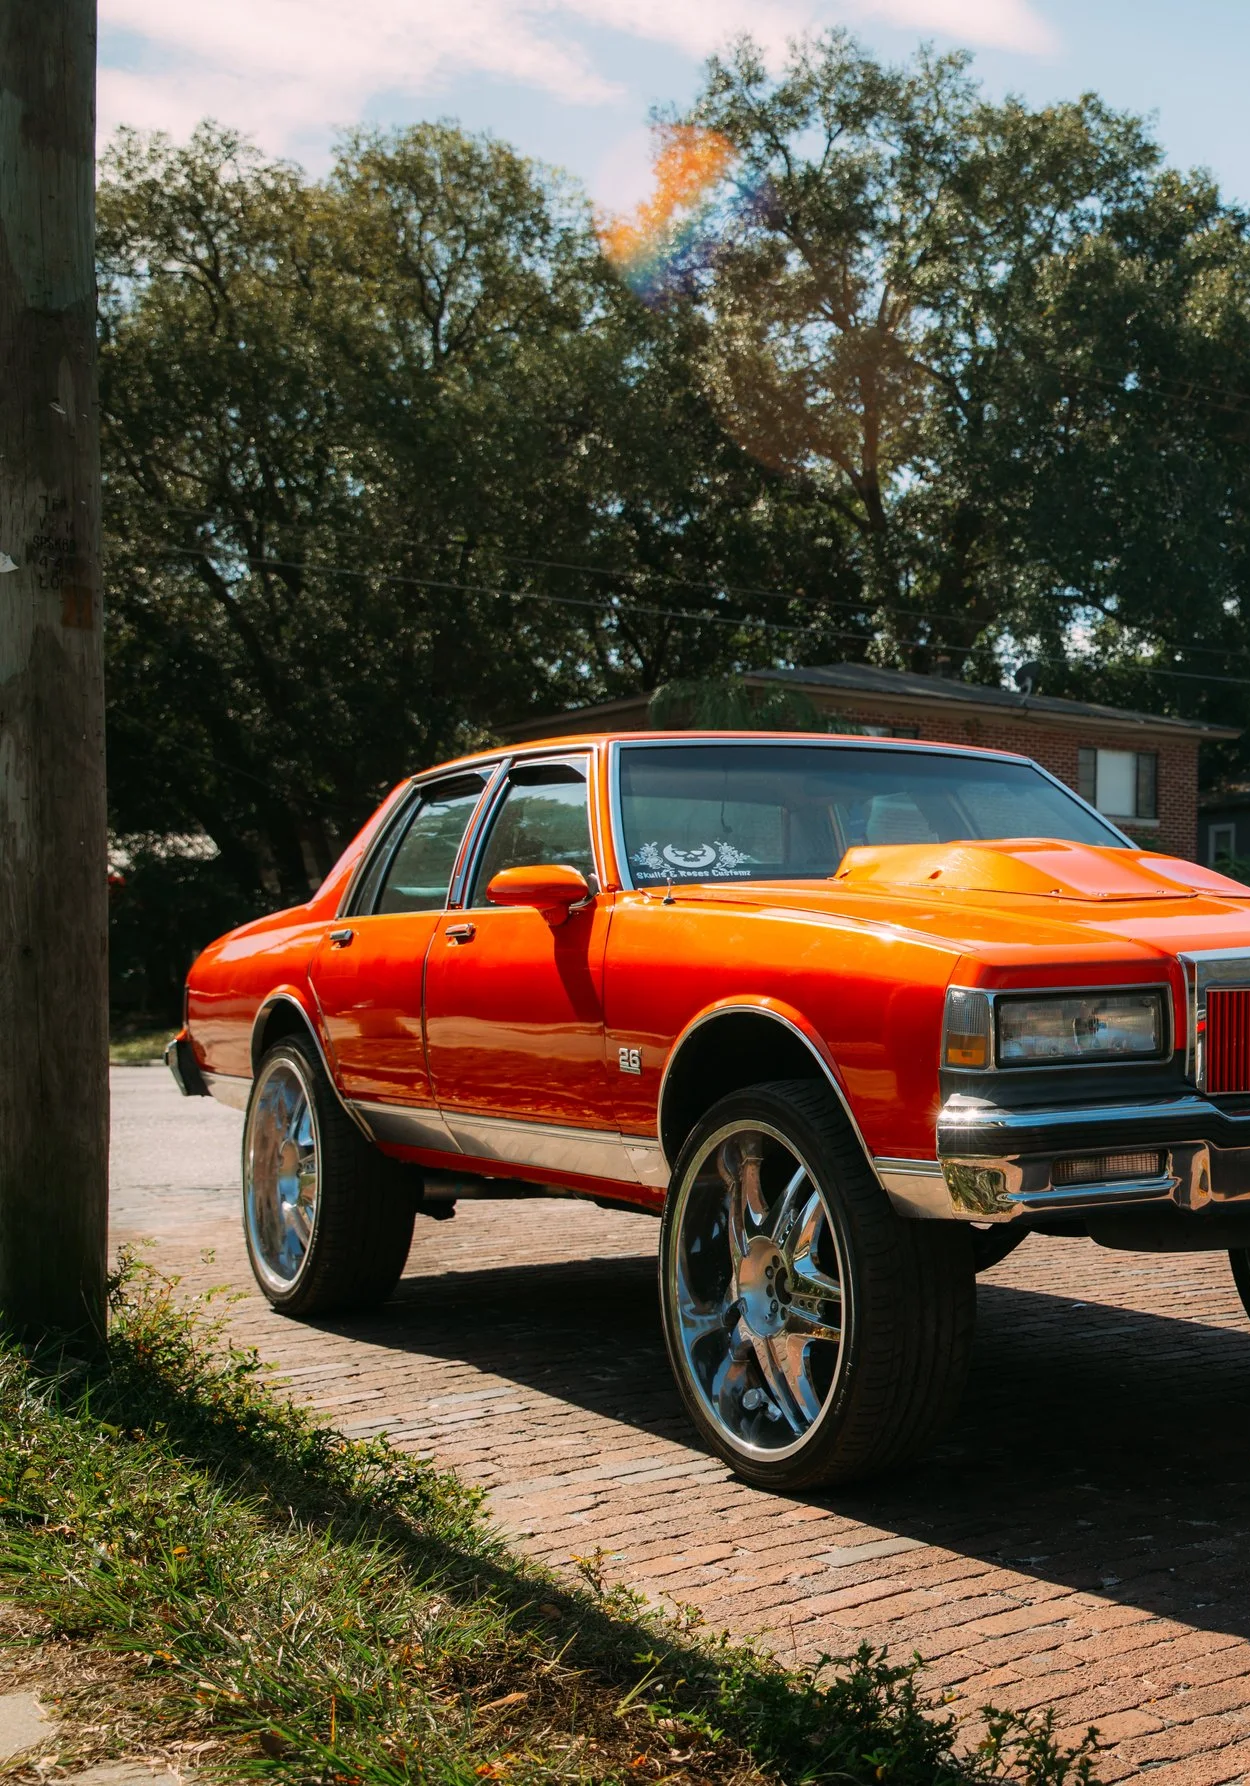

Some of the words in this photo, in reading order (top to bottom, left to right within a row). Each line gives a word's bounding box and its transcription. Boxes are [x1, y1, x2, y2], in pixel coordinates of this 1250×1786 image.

[636, 870, 667, 880] Skulls
[678, 869, 710, 878] Roses
[711, 868, 751, 878] Customz
[619, 1047, 641, 1069] 26
